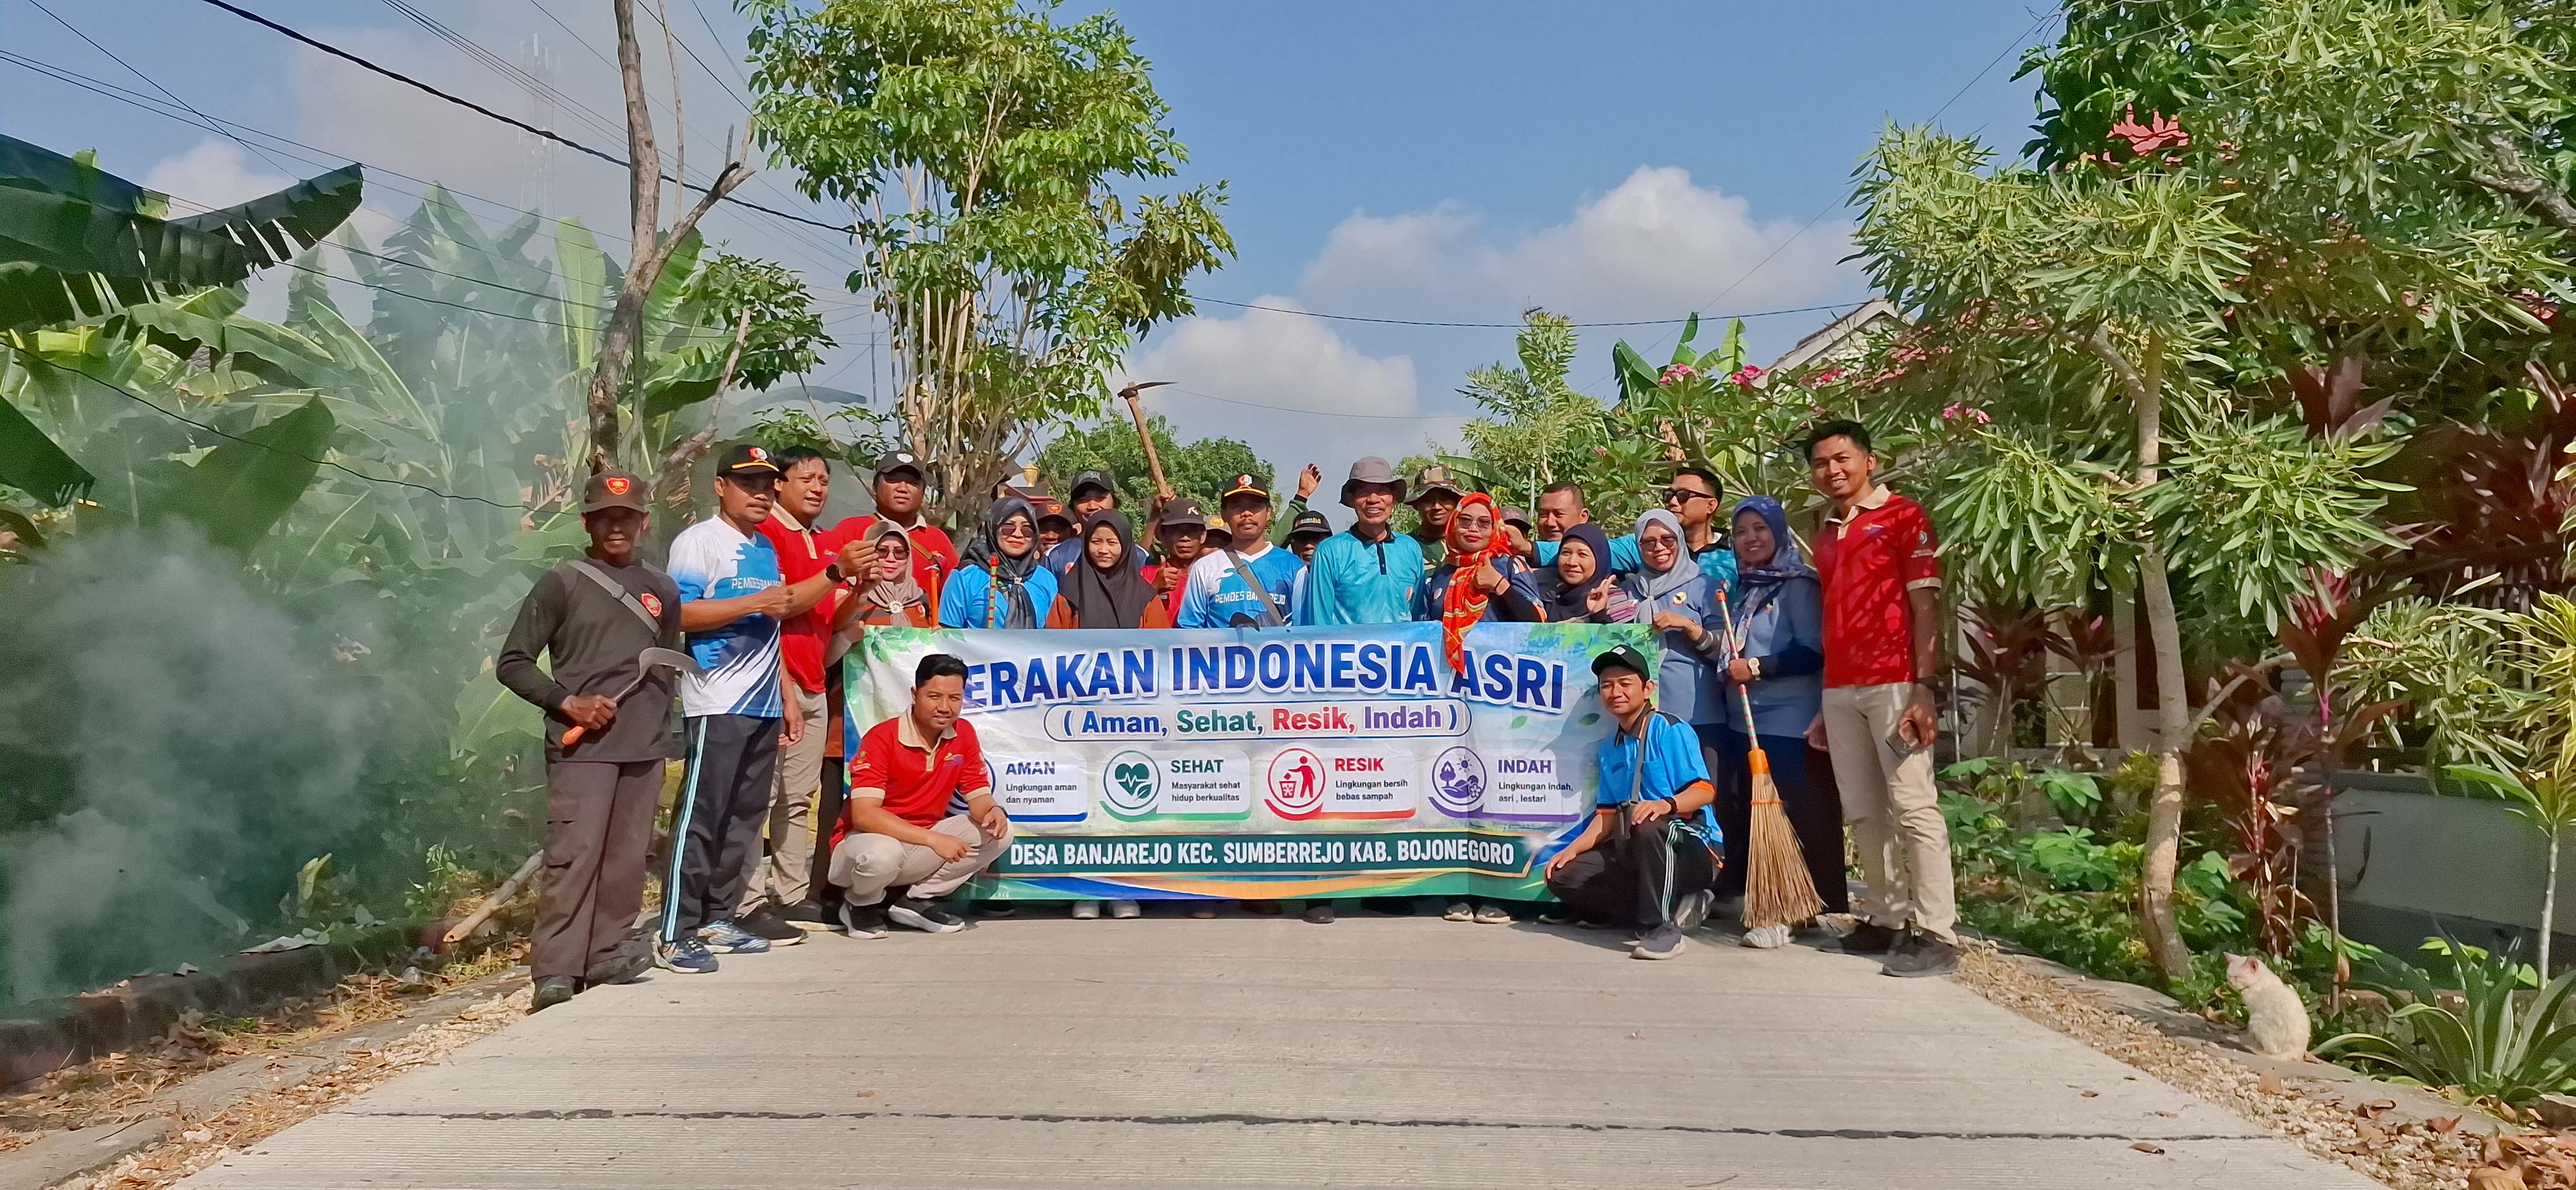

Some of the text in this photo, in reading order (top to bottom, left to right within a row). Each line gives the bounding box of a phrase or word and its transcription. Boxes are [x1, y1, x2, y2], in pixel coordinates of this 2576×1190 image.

[1215, 591, 1245, 604] PEMDES
[962, 643, 1564, 710] ERAKAN INDONESIA ASRI
[1081, 711, 1168, 736] Aman,
[1176, 709, 1263, 735] Sehat,
[1272, 707, 1356, 733] Resik,
[1364, 705, 1441, 729] Indah
[1006, 761, 1055, 775] AMAN
[1171, 759, 1224, 773] SEHAT
[1335, 758, 1385, 771] RESIK
[1498, 760, 1551, 773] INDAH
[1006, 783, 1052, 793] Lingkungan
[1172, 781, 1217, 791] Masyarakat
[1335, 779, 1408, 790] Lingkungan bersih
[1498, 781, 1546, 791] Lingkungan
[1023, 796, 1054, 805] nyaman
[1172, 793, 1240, 803] hidup berkualitas
[1336, 792, 1393, 802] bebas sampah
[1499, 794, 1513, 802] asri
[1520, 794, 1546, 803] lestari
[1011, 839, 1515, 865] DESA BANJAREJO KEC. SUMBERREJO KAB. BOJONEGORO
